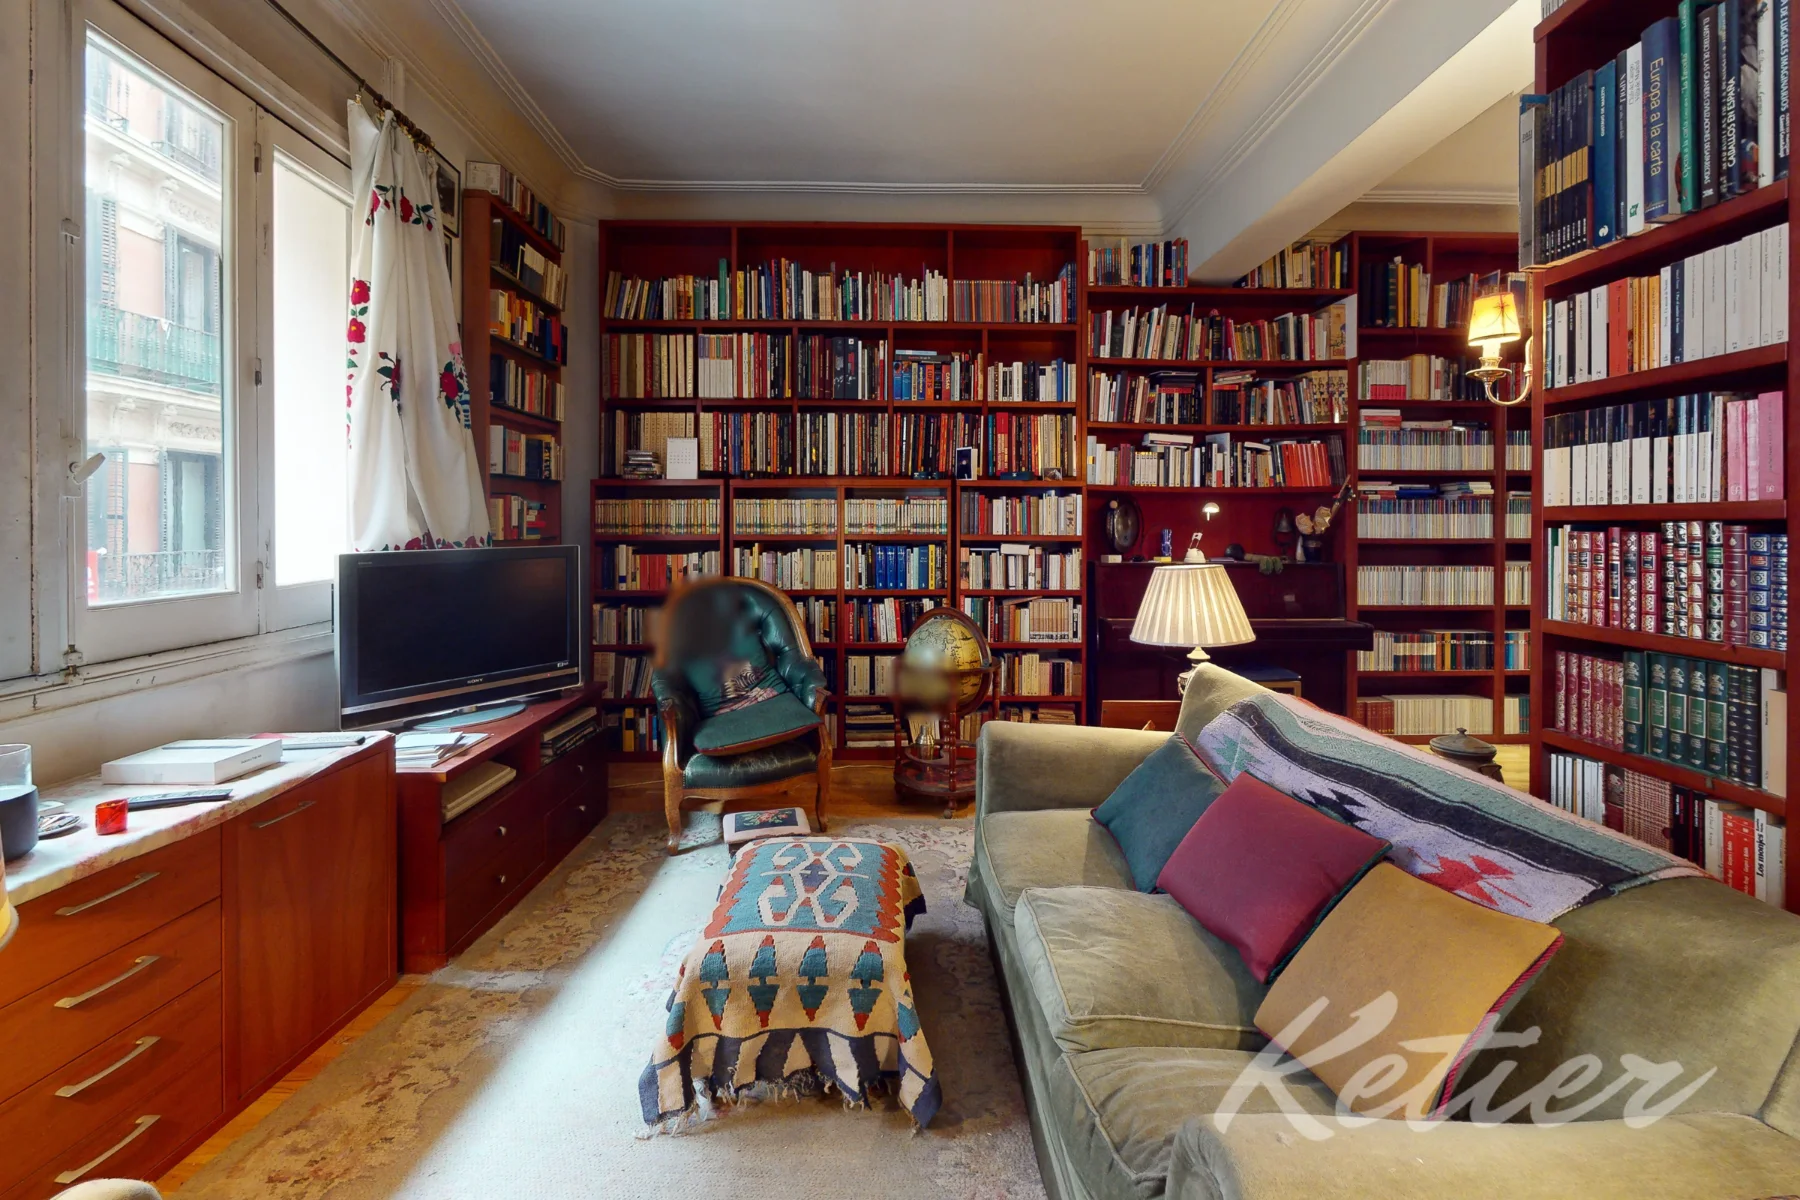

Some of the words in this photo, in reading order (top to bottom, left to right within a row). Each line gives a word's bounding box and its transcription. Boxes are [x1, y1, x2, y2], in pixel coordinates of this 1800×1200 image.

[1780, 19, 1788, 55] LUGARES
[1649, 57, 1663, 109] Europa
[1703, 72, 1711, 98] GRANDES
[1726, 76, 1735, 109] ESPAÑA
[1780, 56, 1789, 111] IMAGINARIOS
[1650, 111, 1661, 123] a
[1651, 123, 1664, 138] la
[1727, 111, 1735, 121] EN
[1650, 141, 1664, 177] carta
[1727, 123, 1736, 167] CABALLOS
[1756, 833, 1766, 863] monjes
[1756, 864, 1764, 878] Los
